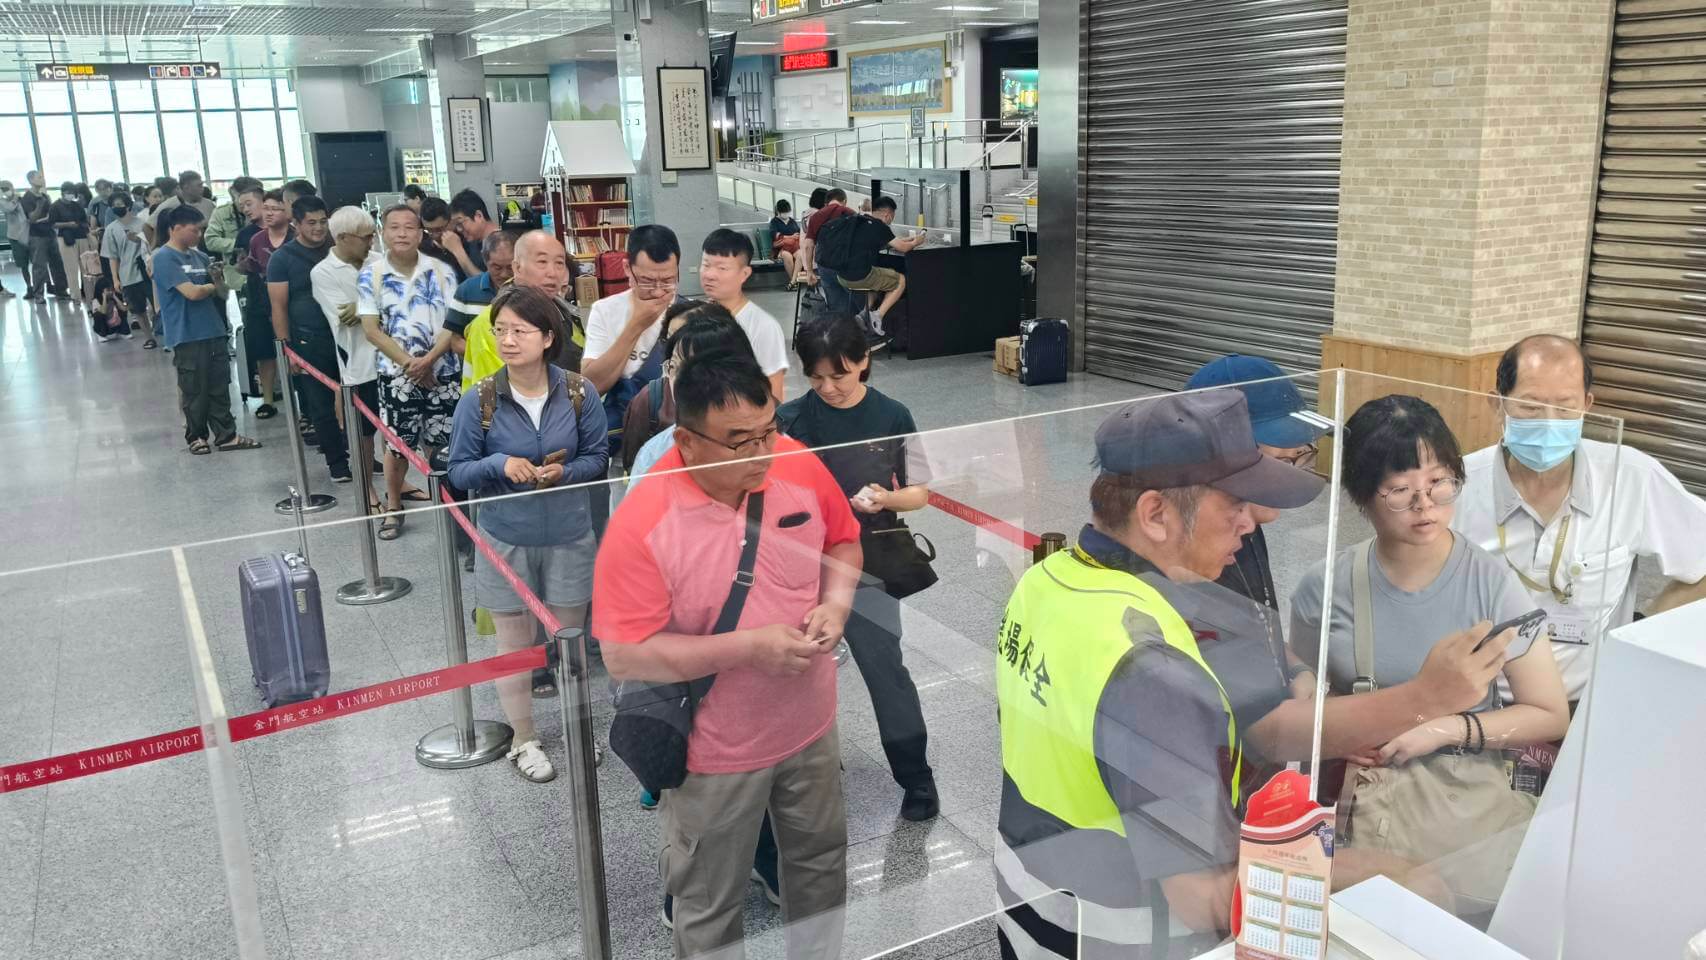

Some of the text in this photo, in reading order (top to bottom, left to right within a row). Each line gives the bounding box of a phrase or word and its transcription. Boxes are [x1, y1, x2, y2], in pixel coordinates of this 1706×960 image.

[337, 675, 441, 710] KINMEN AIRPORT
[253, 705, 324, 730] 金門航空站
[79, 733, 200, 770] KINMEN AIRPORT
